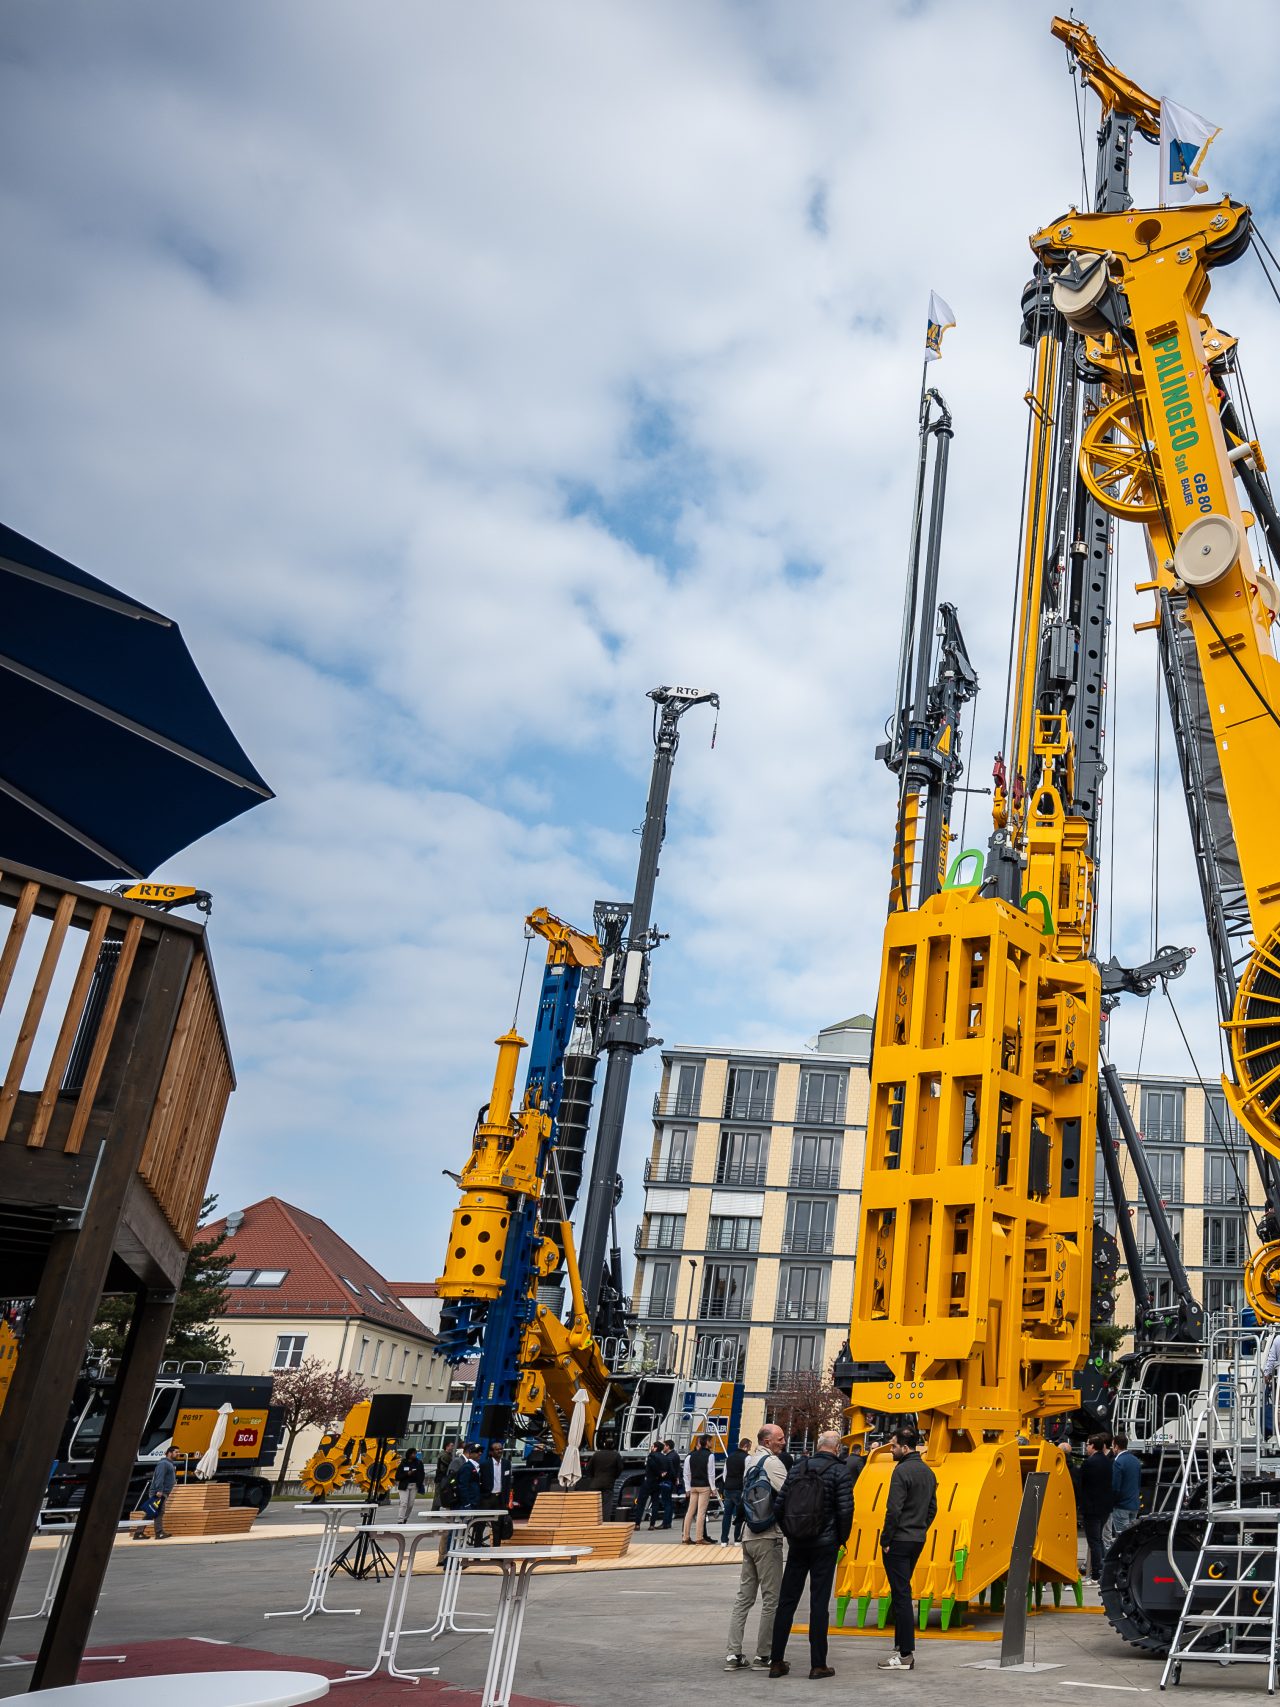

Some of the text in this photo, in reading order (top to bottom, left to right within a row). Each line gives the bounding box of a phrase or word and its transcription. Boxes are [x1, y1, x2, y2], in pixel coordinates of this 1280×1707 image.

[1152, 335, 1200, 452] PALINGEO
[1180, 477, 1194, 506] BAUER
[1193, 473, 1212, 513] GB 80
[676, 686, 699, 696] RTG
[139, 885, 176, 897] RTG
[237, 1434, 254, 1442] ECA
